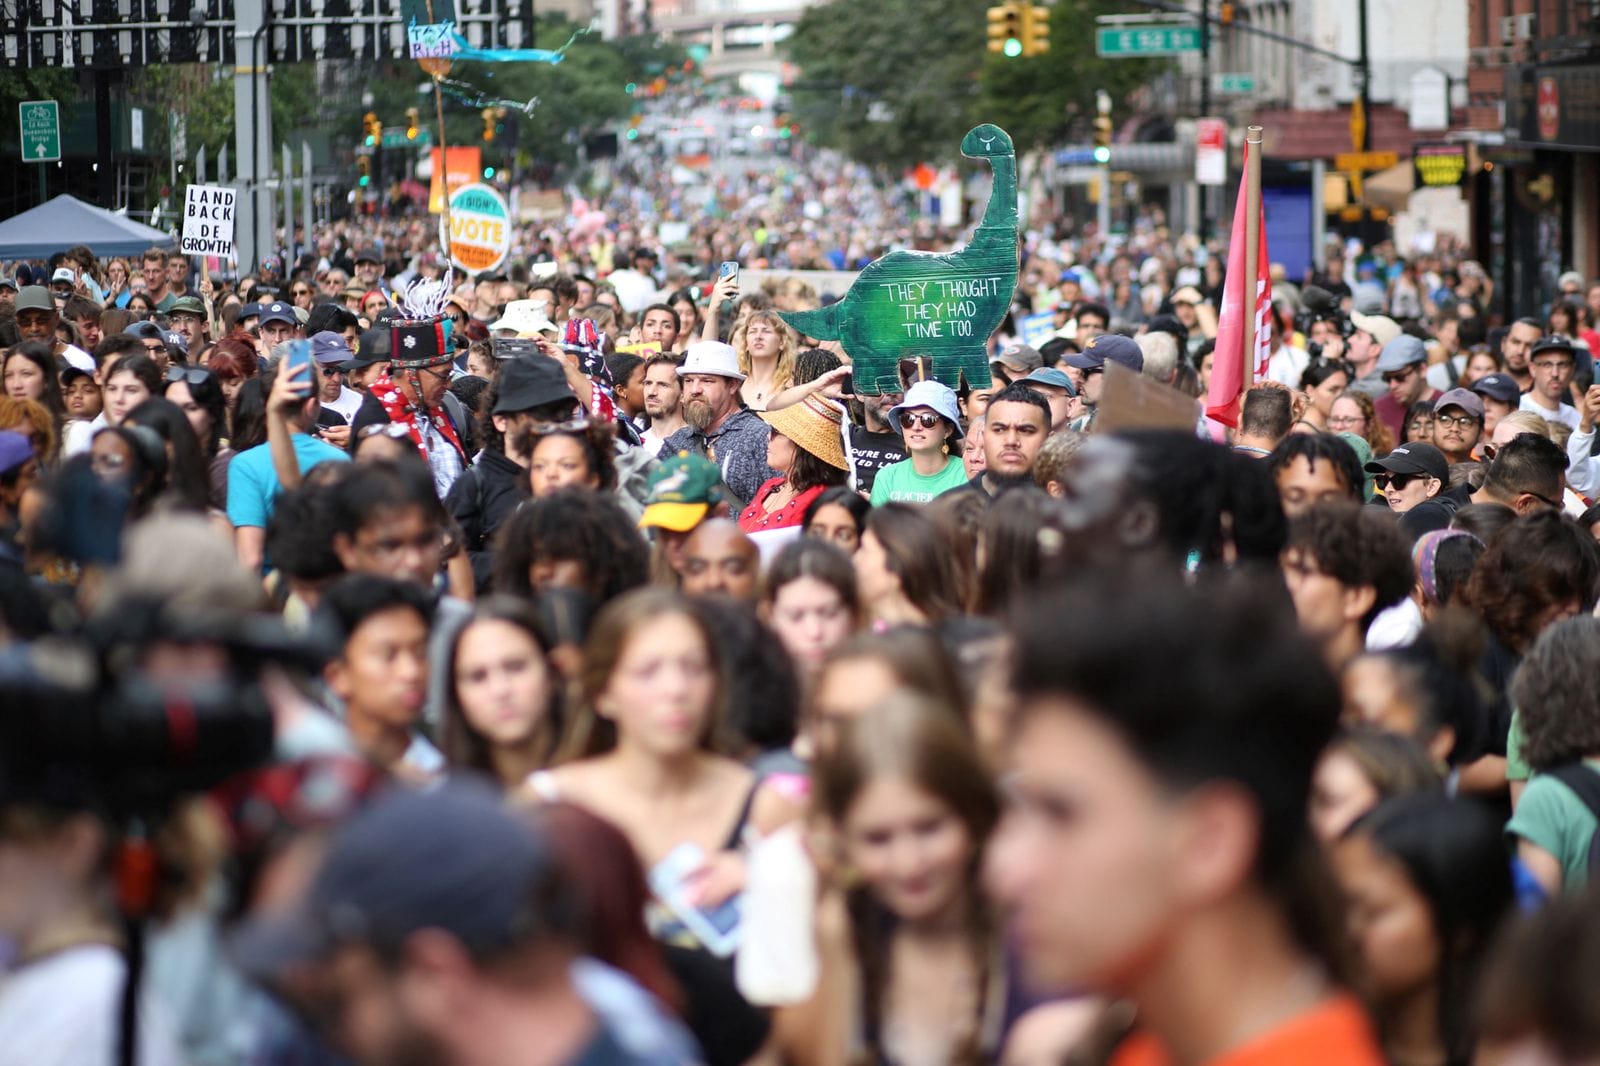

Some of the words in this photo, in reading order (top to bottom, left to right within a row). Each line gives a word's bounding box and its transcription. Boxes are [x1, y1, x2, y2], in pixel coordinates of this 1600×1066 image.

[190, 189, 233, 206] LAND
[188, 204, 231, 221] BACK
[450, 217, 503, 244] VOTE
[182, 237, 231, 254] GROWTH
[880, 281, 928, 302] THEY
[935, 278, 1001, 298] THOUGHT
[899, 303, 943, 320] THEY
[947, 301, 976, 318] HAD
[902, 321, 943, 338] TIME
[946, 320, 974, 337] TOO.
[851, 448, 880, 459] OU'RE
[885, 452, 901, 460] ON
[853, 457, 873, 467] TED
[890, 490, 933, 503] GLACIER
